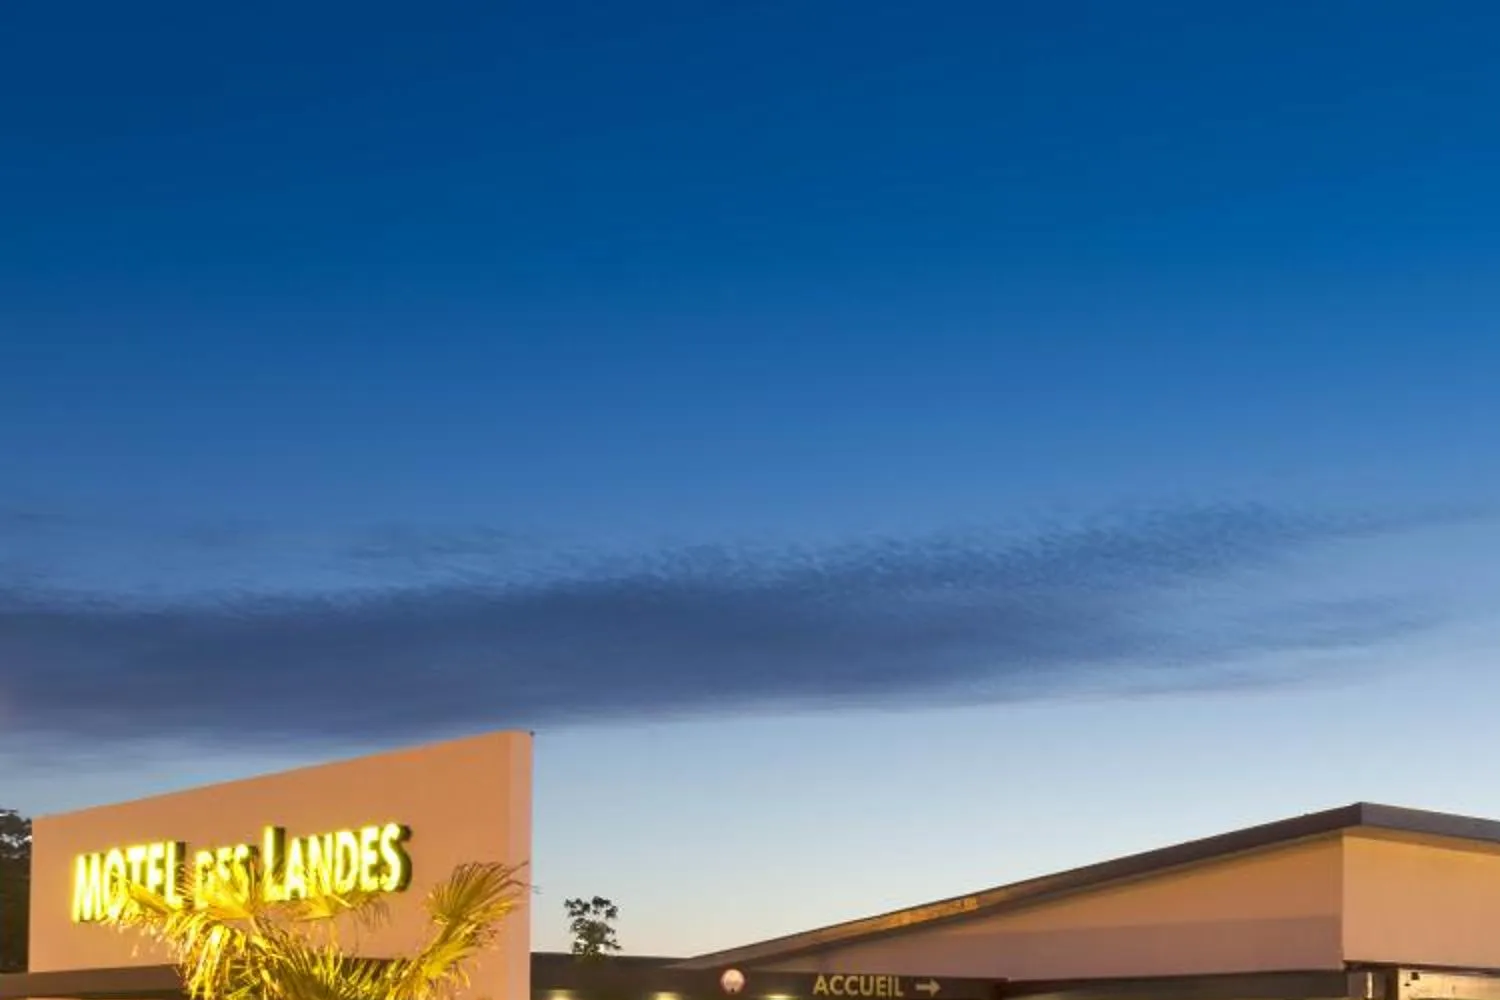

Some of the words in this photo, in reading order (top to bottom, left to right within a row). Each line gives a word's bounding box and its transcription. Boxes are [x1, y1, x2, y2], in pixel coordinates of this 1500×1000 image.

[73, 840, 187, 923] MOTEL
[262, 823, 412, 902] LANDES
[813, 975, 903, 997] ACCUEIL
